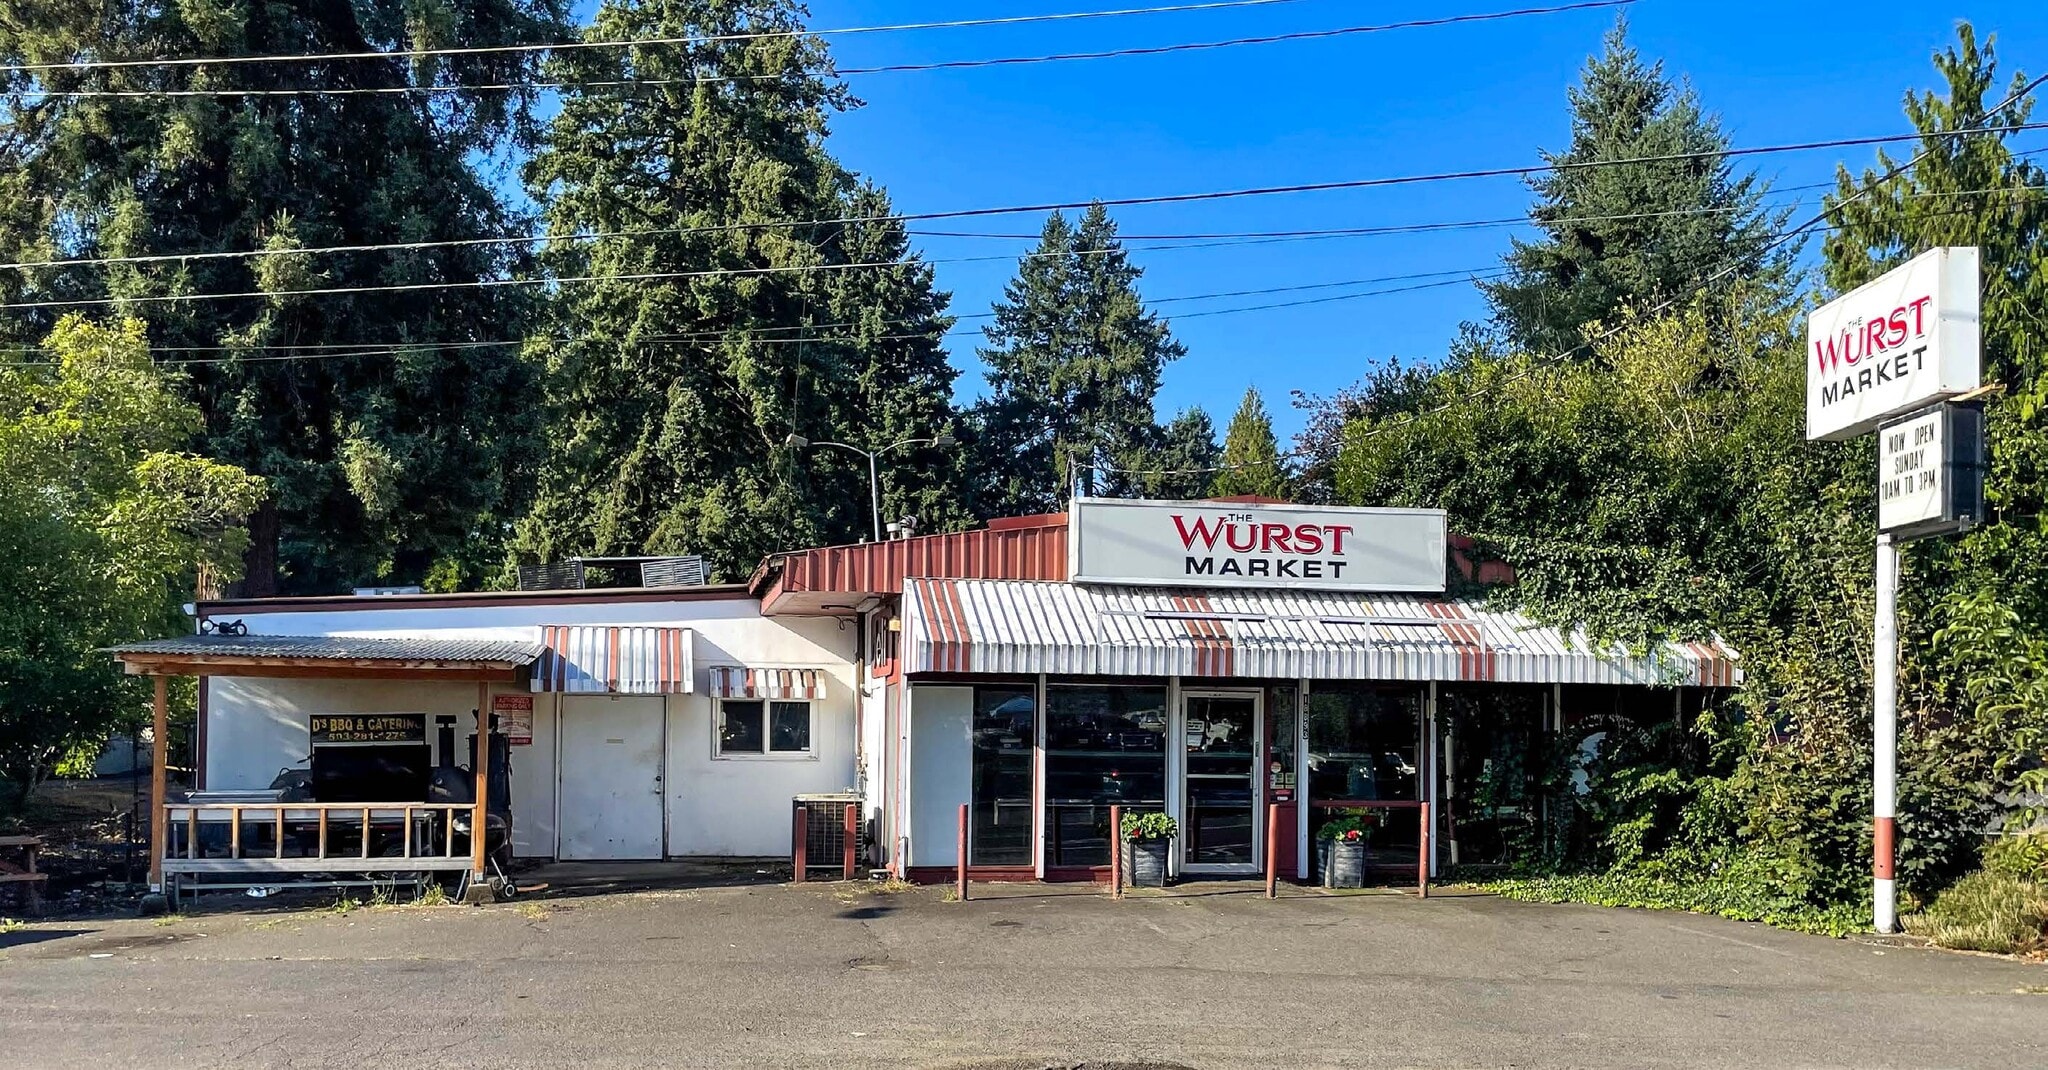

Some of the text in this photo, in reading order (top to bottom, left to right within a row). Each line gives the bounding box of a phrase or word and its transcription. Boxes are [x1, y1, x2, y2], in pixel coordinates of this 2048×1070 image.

[1815, 295, 1932, 377] WURST
[1847, 316, 1863, 329] THE
[1821, 345, 1928, 408] MARKET
[1888, 423, 1935, 454] NOW OPEN
[1894, 449, 1925, 476] SUNDAY
[1882, 469, 1936, 501] 10AM TO 3PM
[1228, 513, 1252, 523] THE
[1170, 514, 1353, 556] WURST
[1185, 556, 1347, 579] MARKET
[330, 719, 353, 731] BBQ
[356, 718, 365, 731] &
